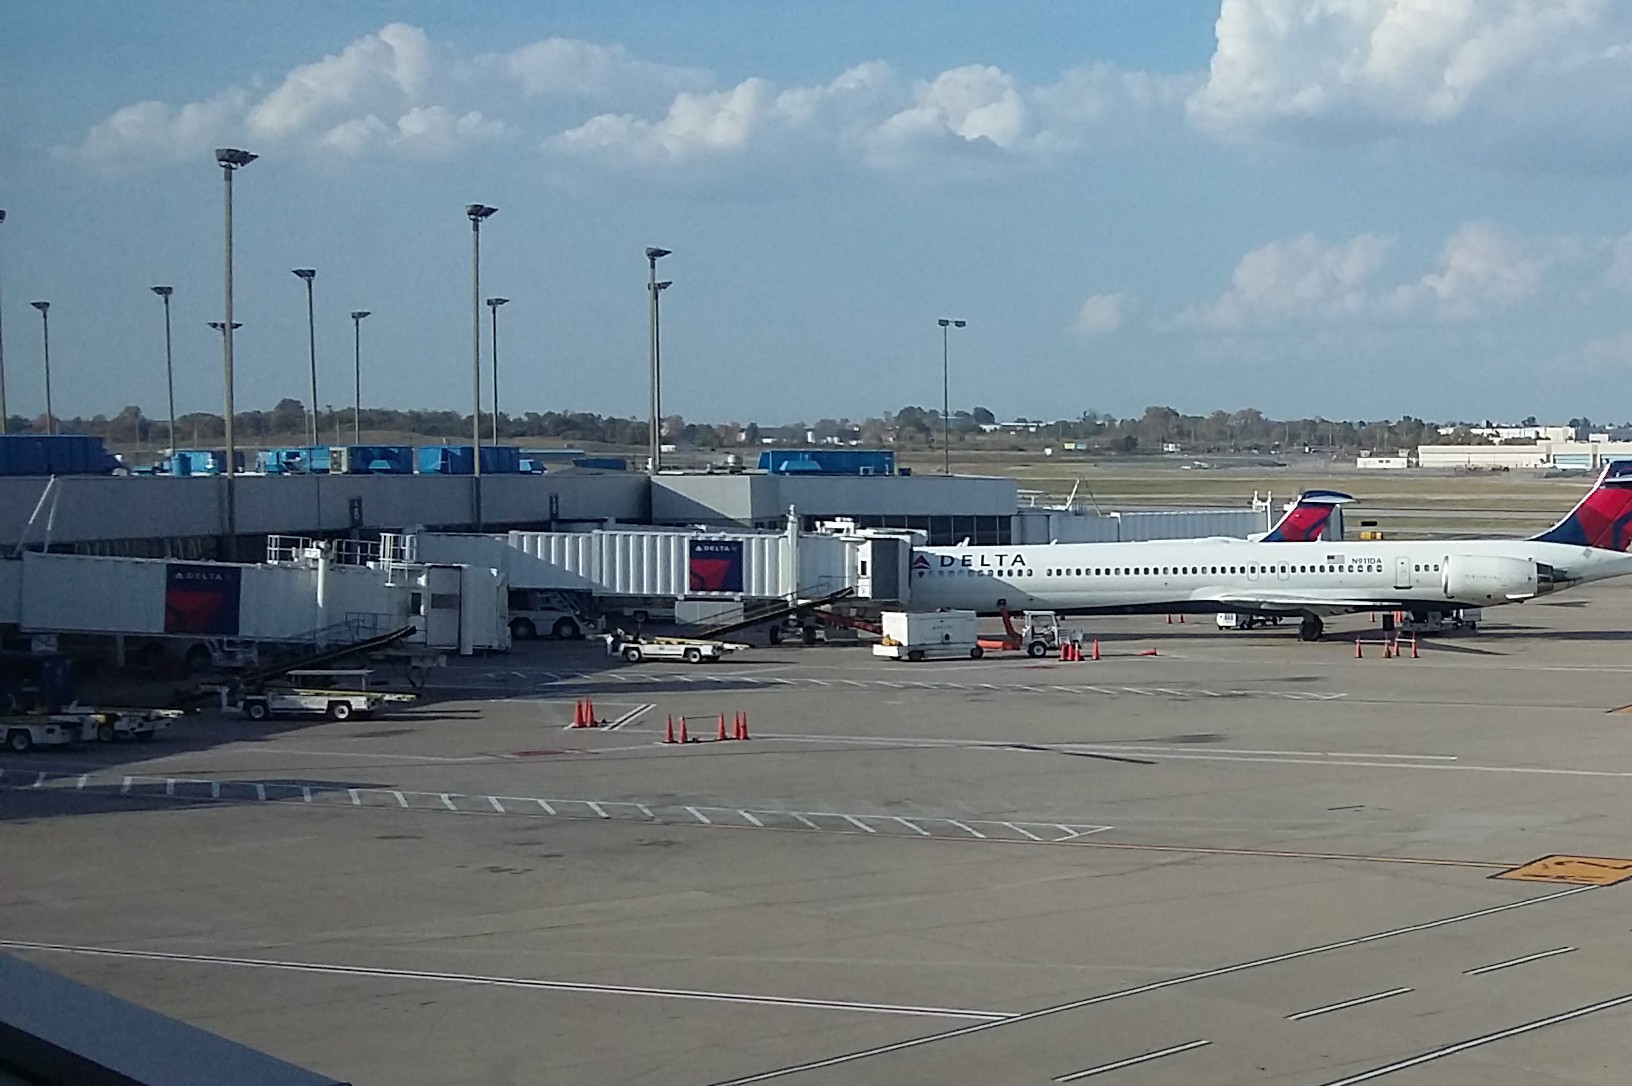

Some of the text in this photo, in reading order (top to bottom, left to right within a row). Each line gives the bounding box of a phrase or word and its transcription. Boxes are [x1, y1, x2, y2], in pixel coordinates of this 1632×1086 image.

[940, 554, 1026, 567] DELTA
[1351, 557, 1382, 565] N911DA
[186, 572, 222, 580] DELTA
